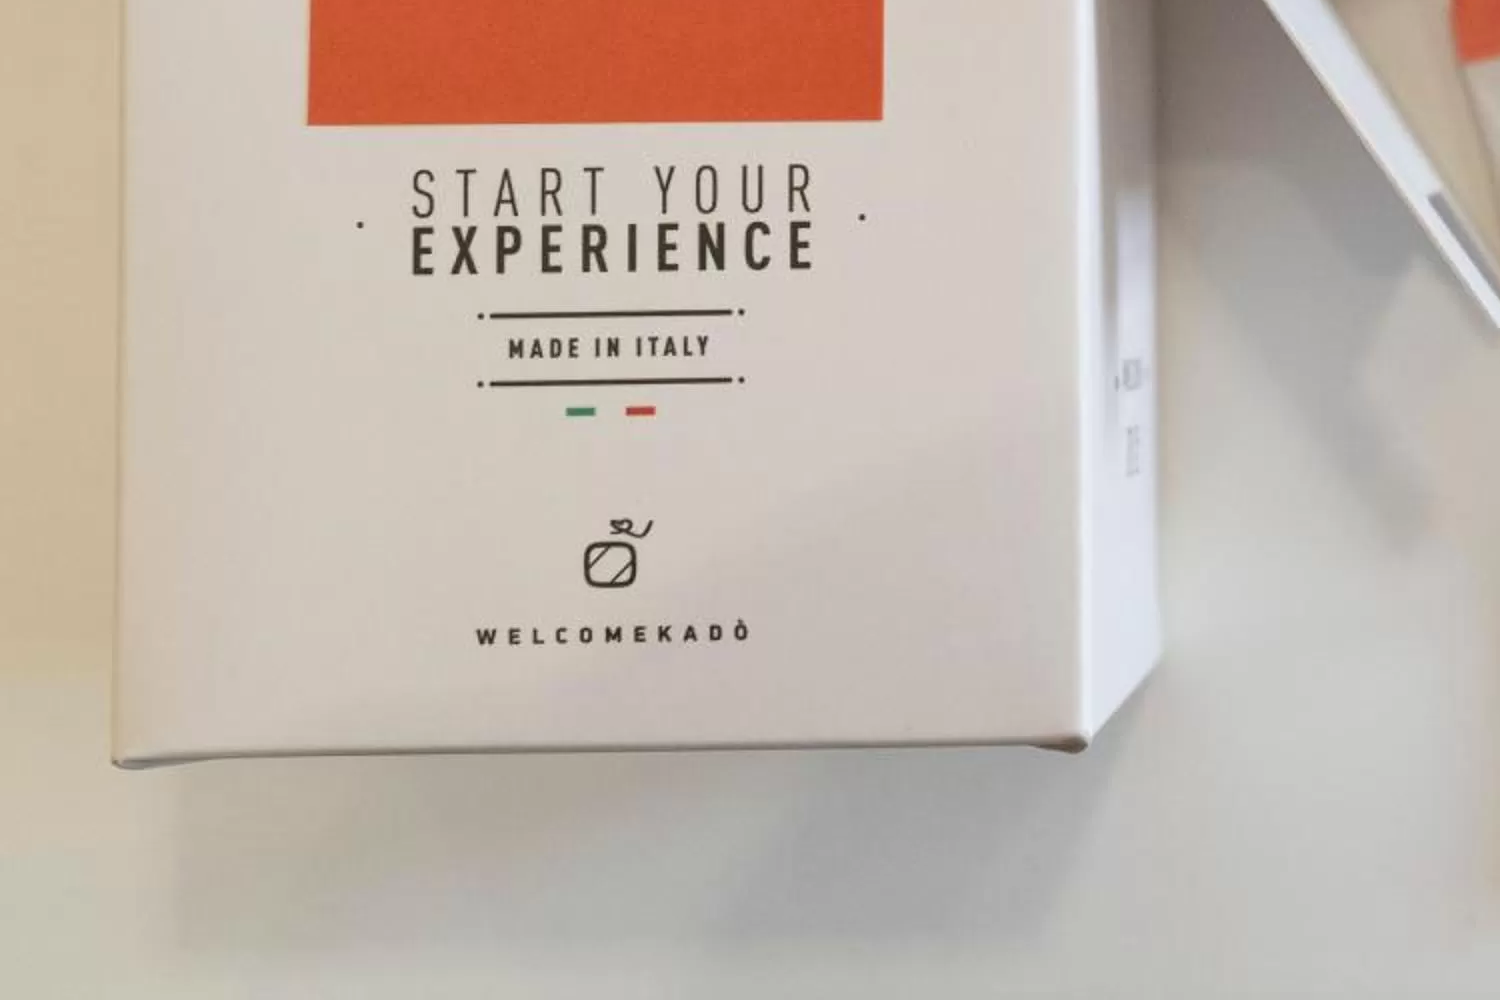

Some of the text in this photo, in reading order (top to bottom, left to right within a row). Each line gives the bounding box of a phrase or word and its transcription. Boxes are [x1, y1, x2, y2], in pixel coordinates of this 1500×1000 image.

[411, 164, 812, 219] START YOUR
[411, 220, 812, 275] EXPERIENCE
[508, 335, 711, 359] MADE IN ITALY
[476, 618, 750, 646] WELCOMEKADÒ
